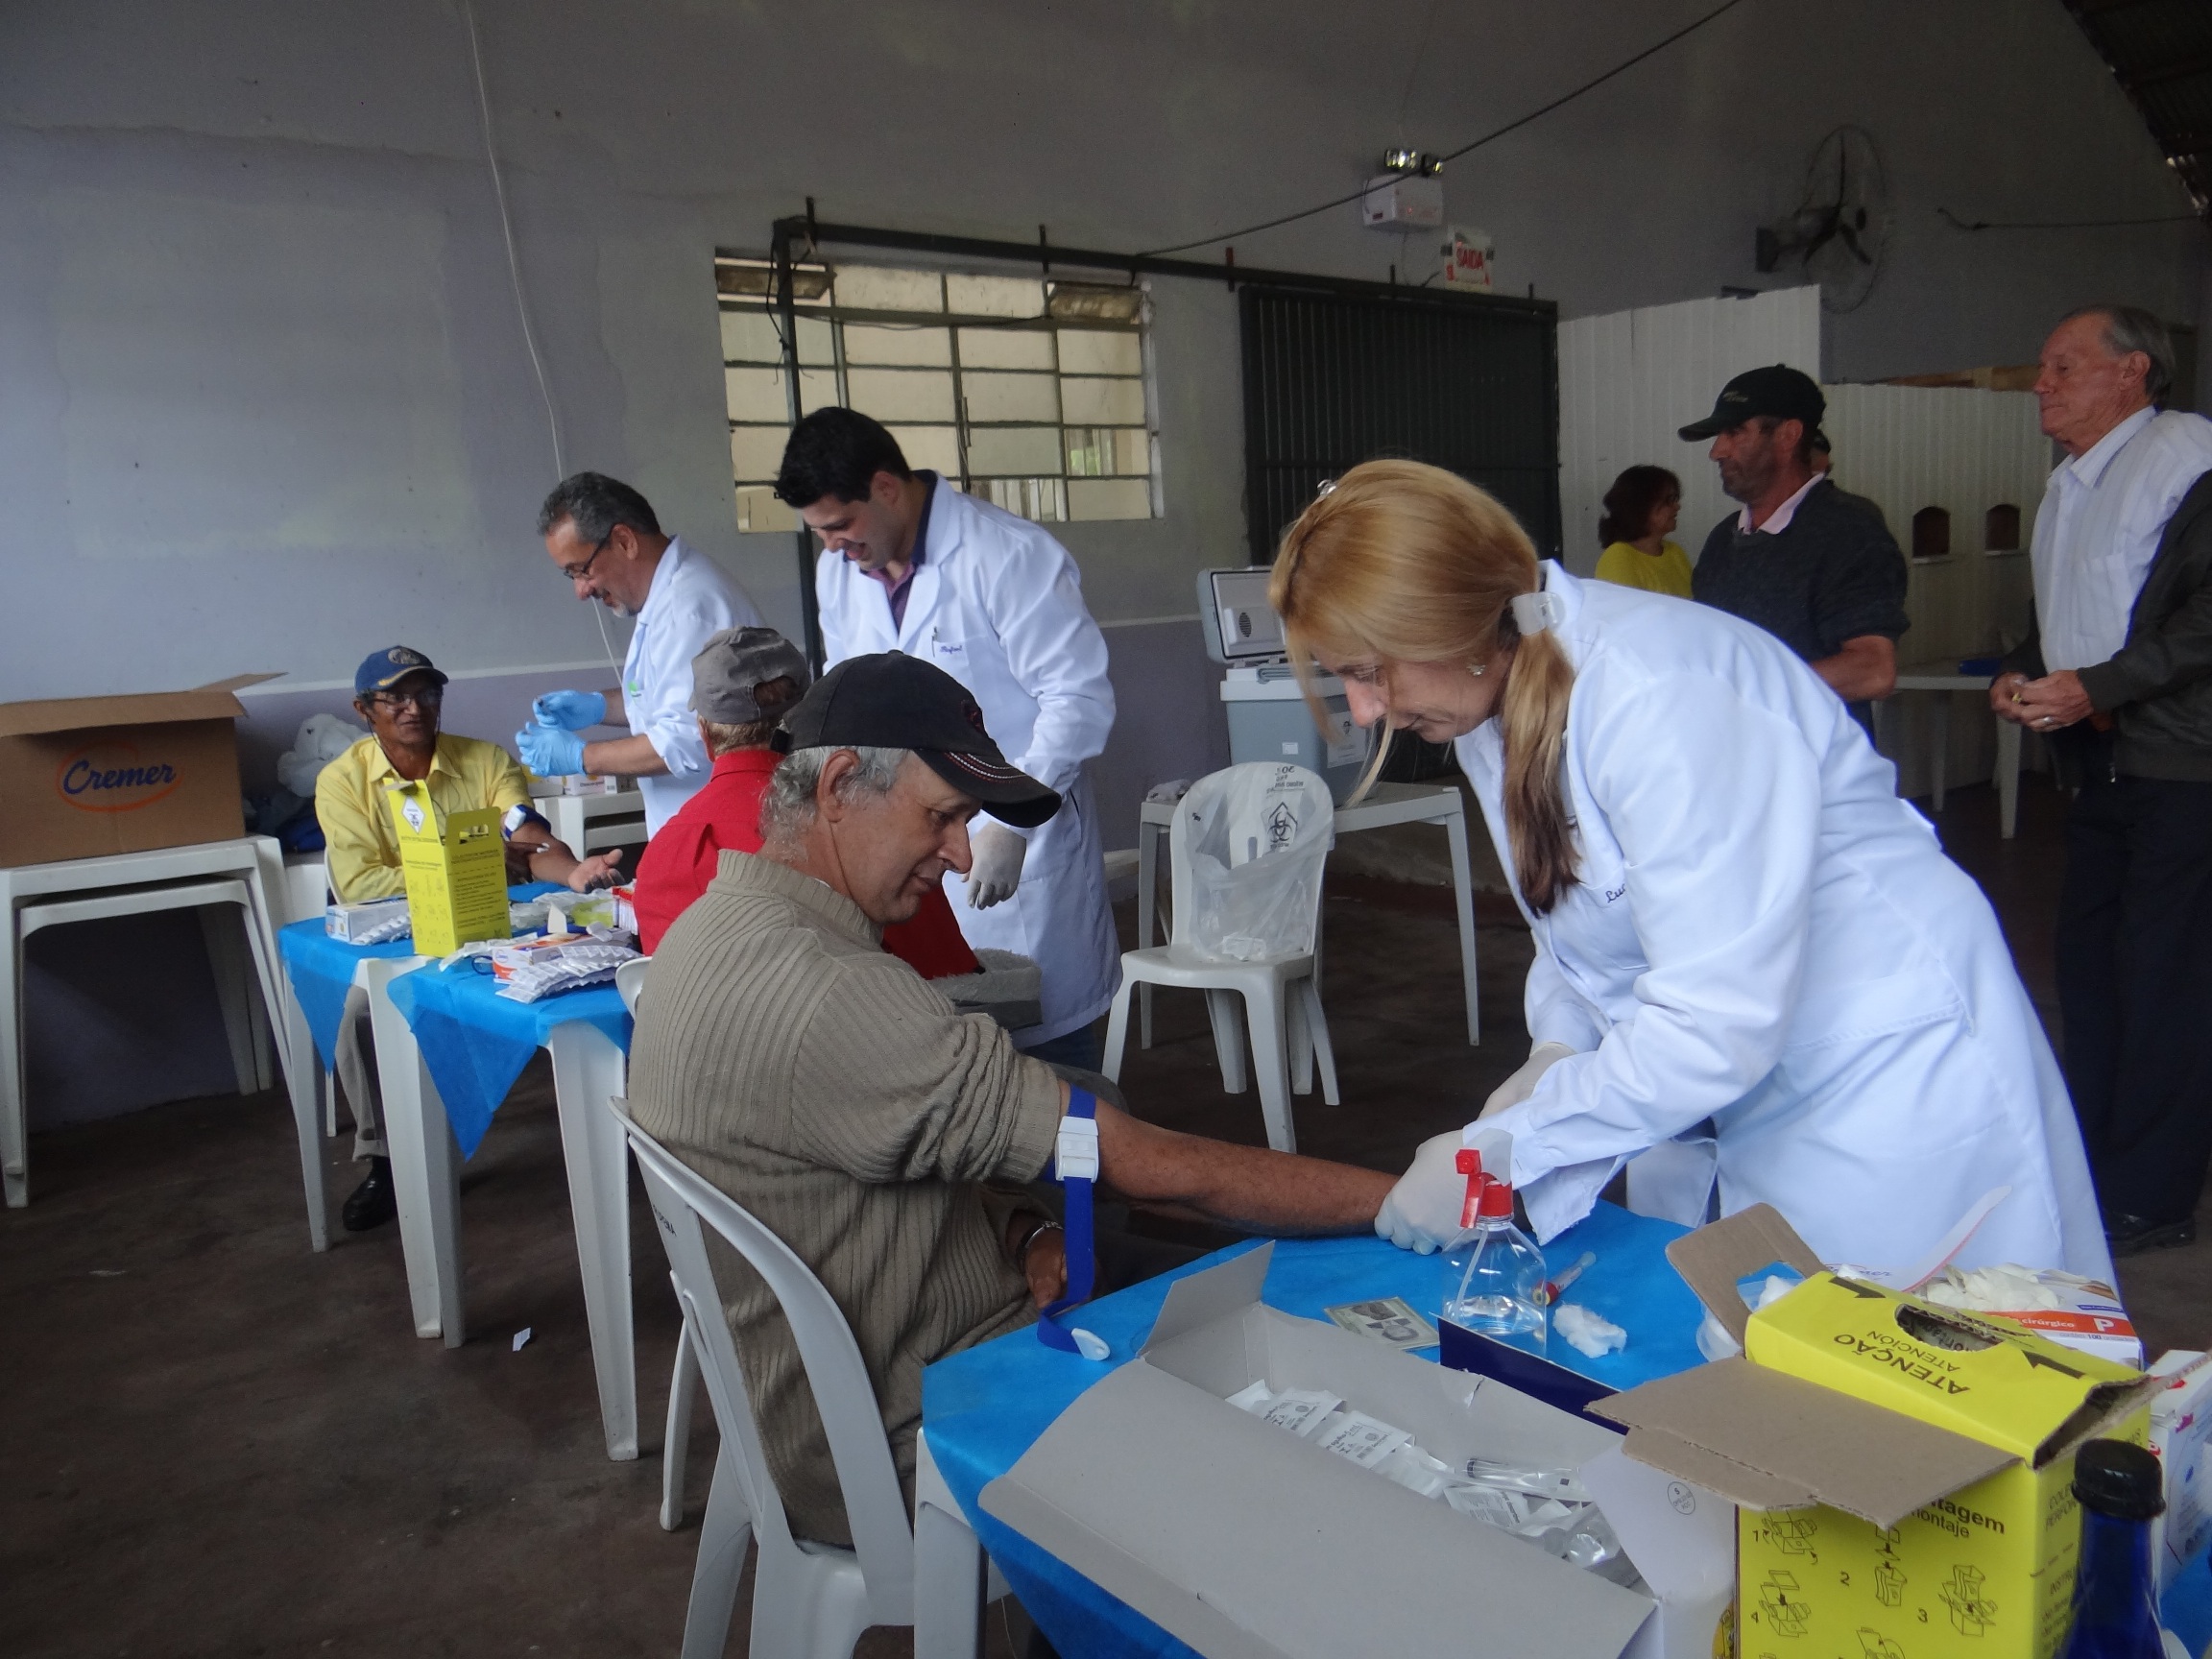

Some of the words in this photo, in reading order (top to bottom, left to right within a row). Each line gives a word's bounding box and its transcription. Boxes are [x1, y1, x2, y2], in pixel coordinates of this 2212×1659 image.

[63, 760, 176, 795] Cremer
[2022, 1318, 2075, 1329] cirúrgico
[2094, 1317, 2115, 1332] P
[1833, 1333, 1971, 1395] ATENÇÃO
[1866, 1330, 1960, 1373] ATENCIÓN
[1931, 1497, 2006, 1535] tagem
[1839, 1571, 1850, 1586] 2
[1750, 1611, 1760, 1623] 4
[1917, 1607, 1928, 1623] 3
